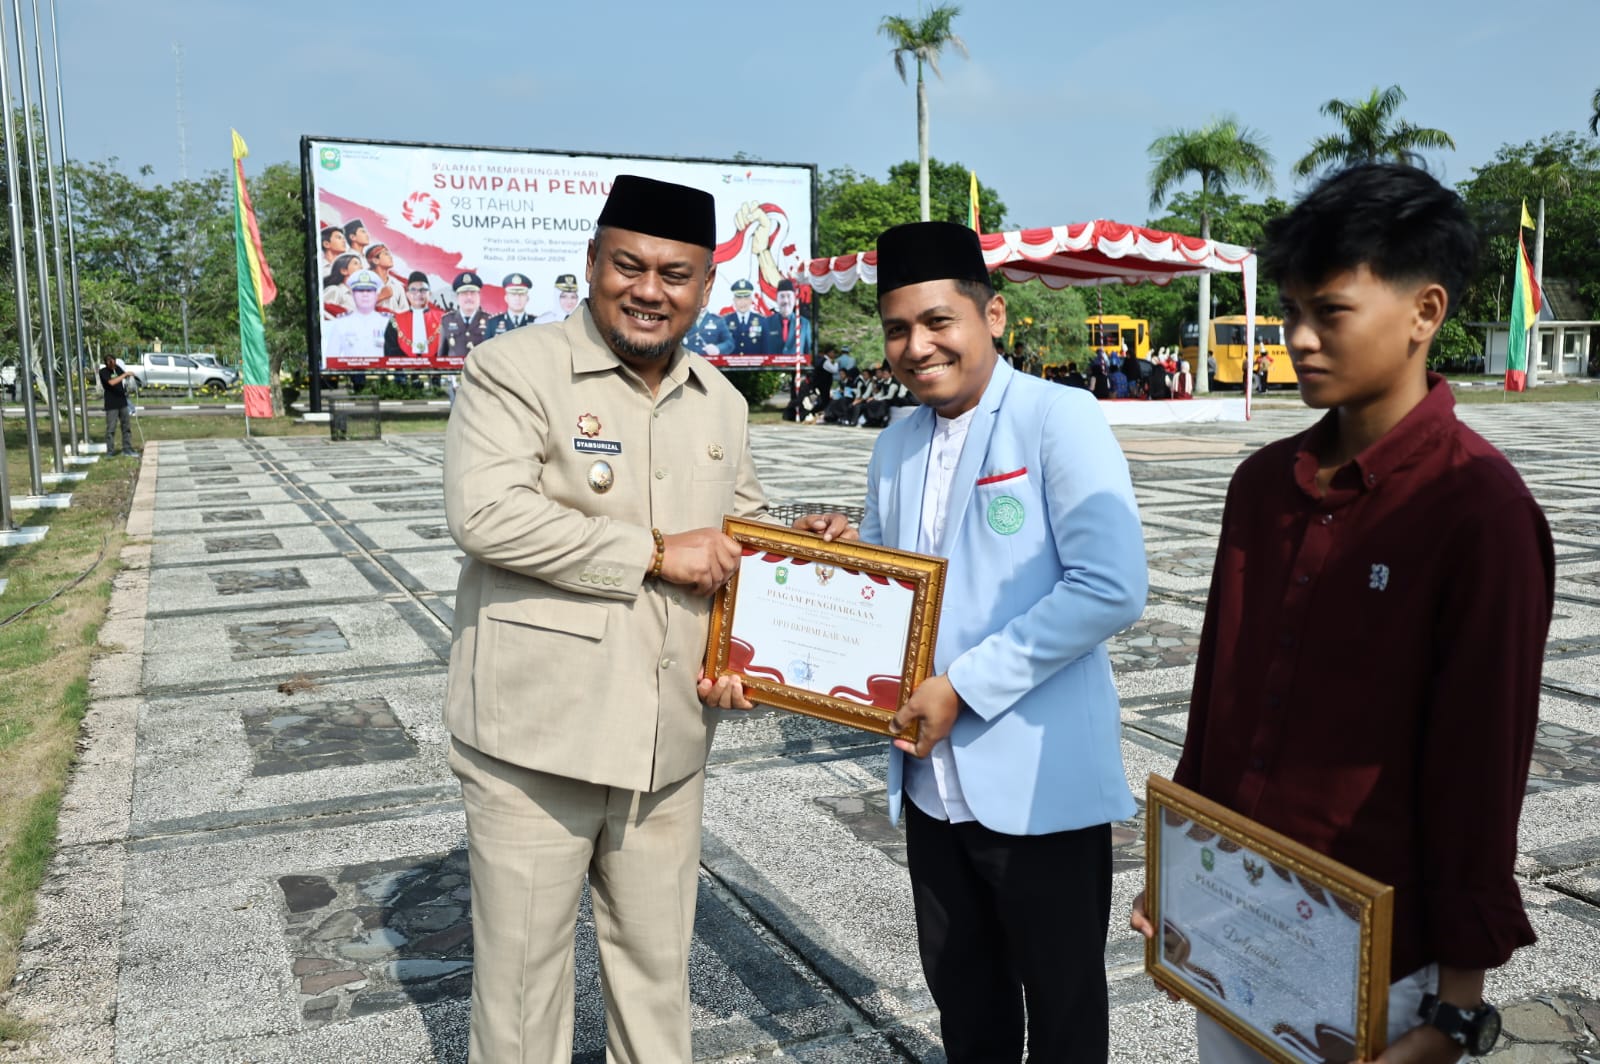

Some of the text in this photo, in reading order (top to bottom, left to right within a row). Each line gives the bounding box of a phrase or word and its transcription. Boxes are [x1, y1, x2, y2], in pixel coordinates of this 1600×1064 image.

[487, 165, 570, 177] MEMPERINGATI
[574, 169, 599, 178] HARI
[433, 173, 538, 193] SUMPAH
[450, 195, 534, 212] 98 TAHUN
[452, 214, 526, 229] SUMPAH
[576, 441, 619, 450] SYAMSURIZAL
[767, 588, 803, 604] PIAGAM
[805, 597, 876, 620] PENGHARGAAN
[1195, 872, 1233, 901] PIAGAM
